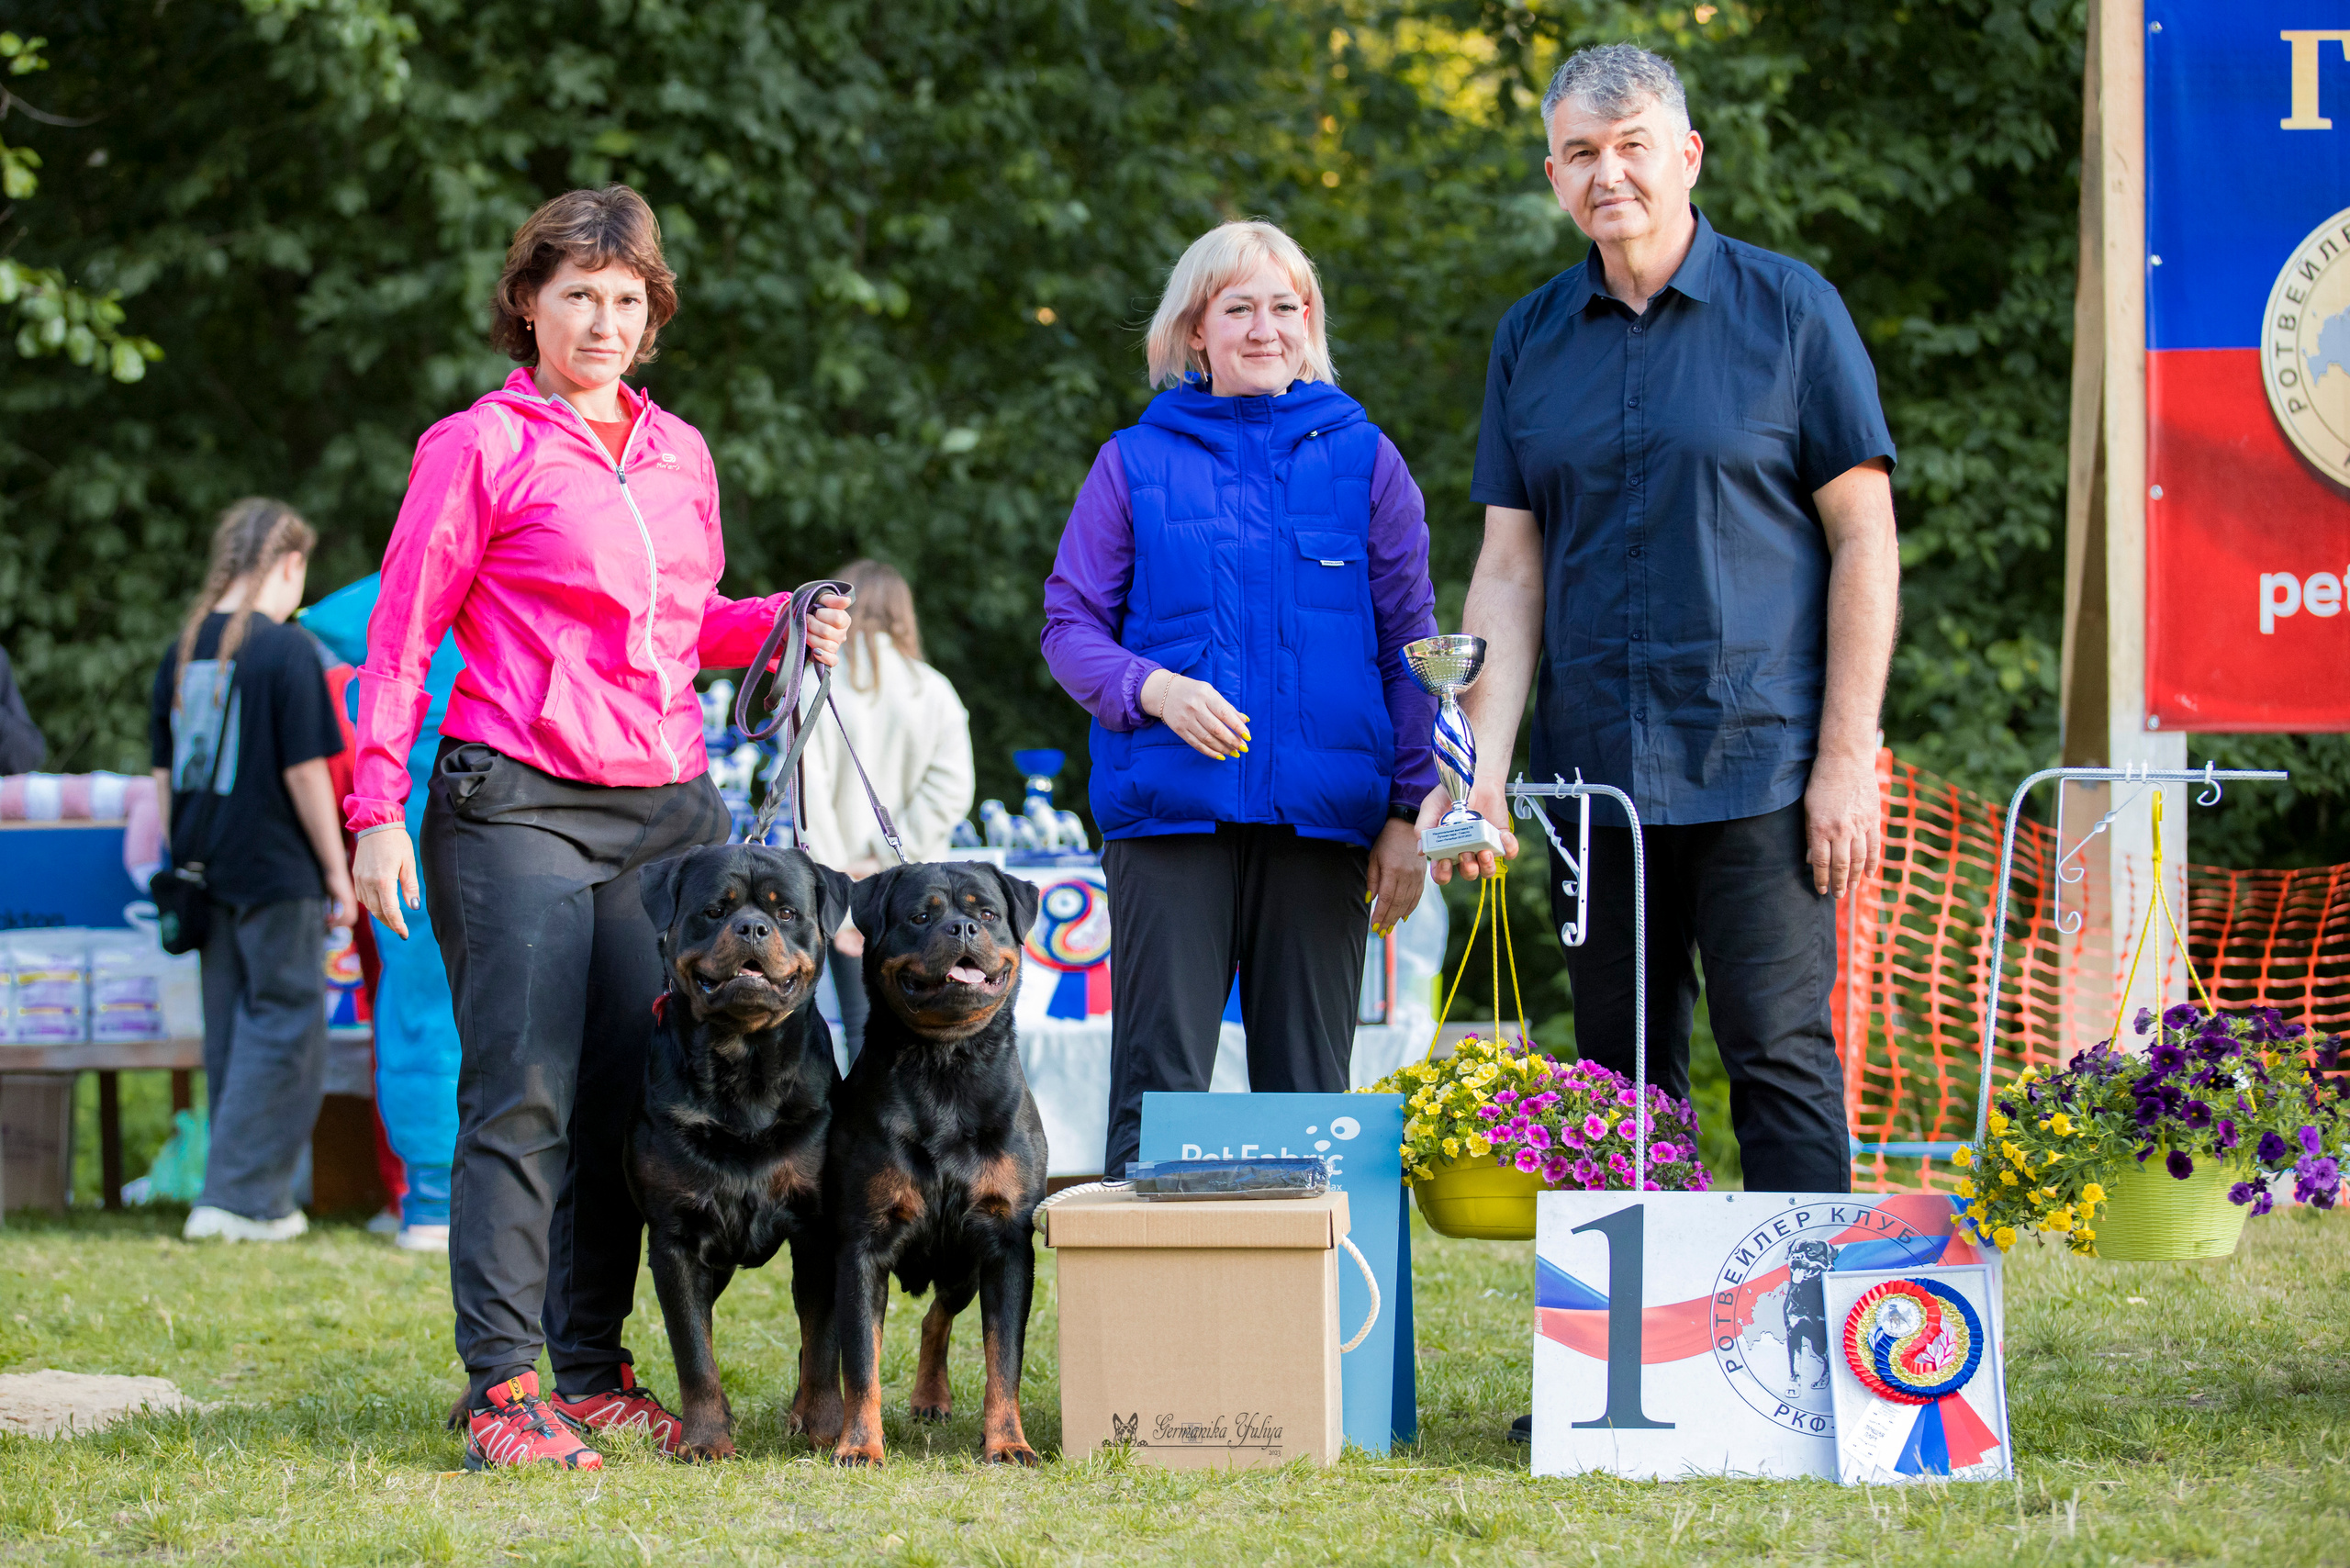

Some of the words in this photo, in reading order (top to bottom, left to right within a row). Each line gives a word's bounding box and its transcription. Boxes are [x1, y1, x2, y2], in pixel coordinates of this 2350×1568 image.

[1571, 1204, 1676, 1429] 1
[1716, 1211, 1810, 1373] РОТВЕЙЛЕР
[1831, 1207, 1915, 1245] КЛУБ
